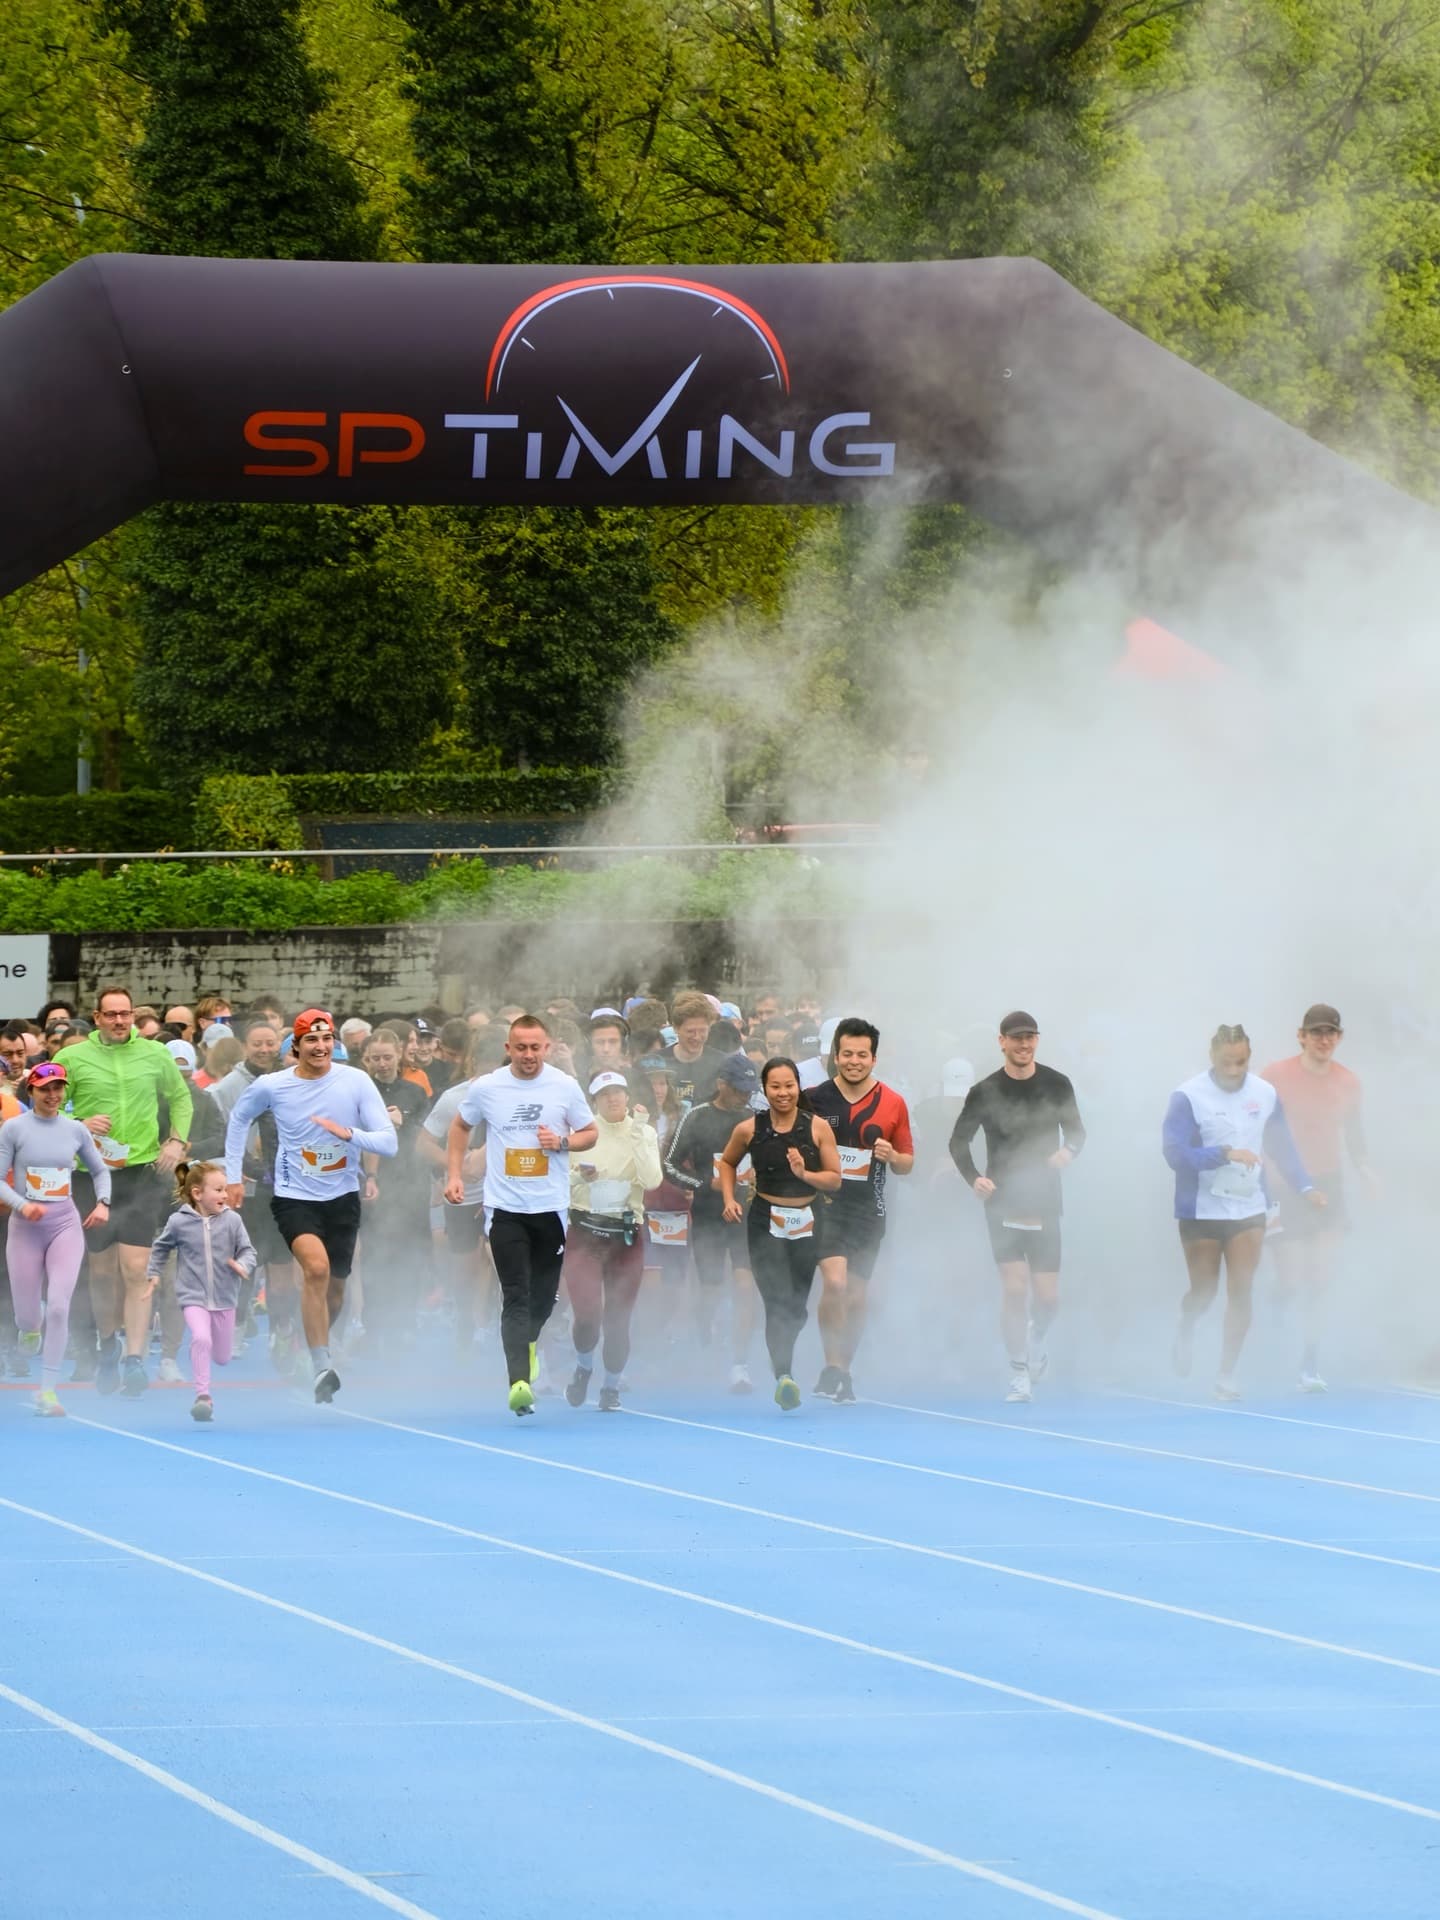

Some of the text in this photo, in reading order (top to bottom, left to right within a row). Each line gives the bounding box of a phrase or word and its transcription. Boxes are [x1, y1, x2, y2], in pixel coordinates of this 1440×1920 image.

[317, 1152, 333, 1160] 713
[519, 1156, 536, 1165] 210
[841, 1153, 857, 1163] 707
[785, 1216, 800, 1225] 706
